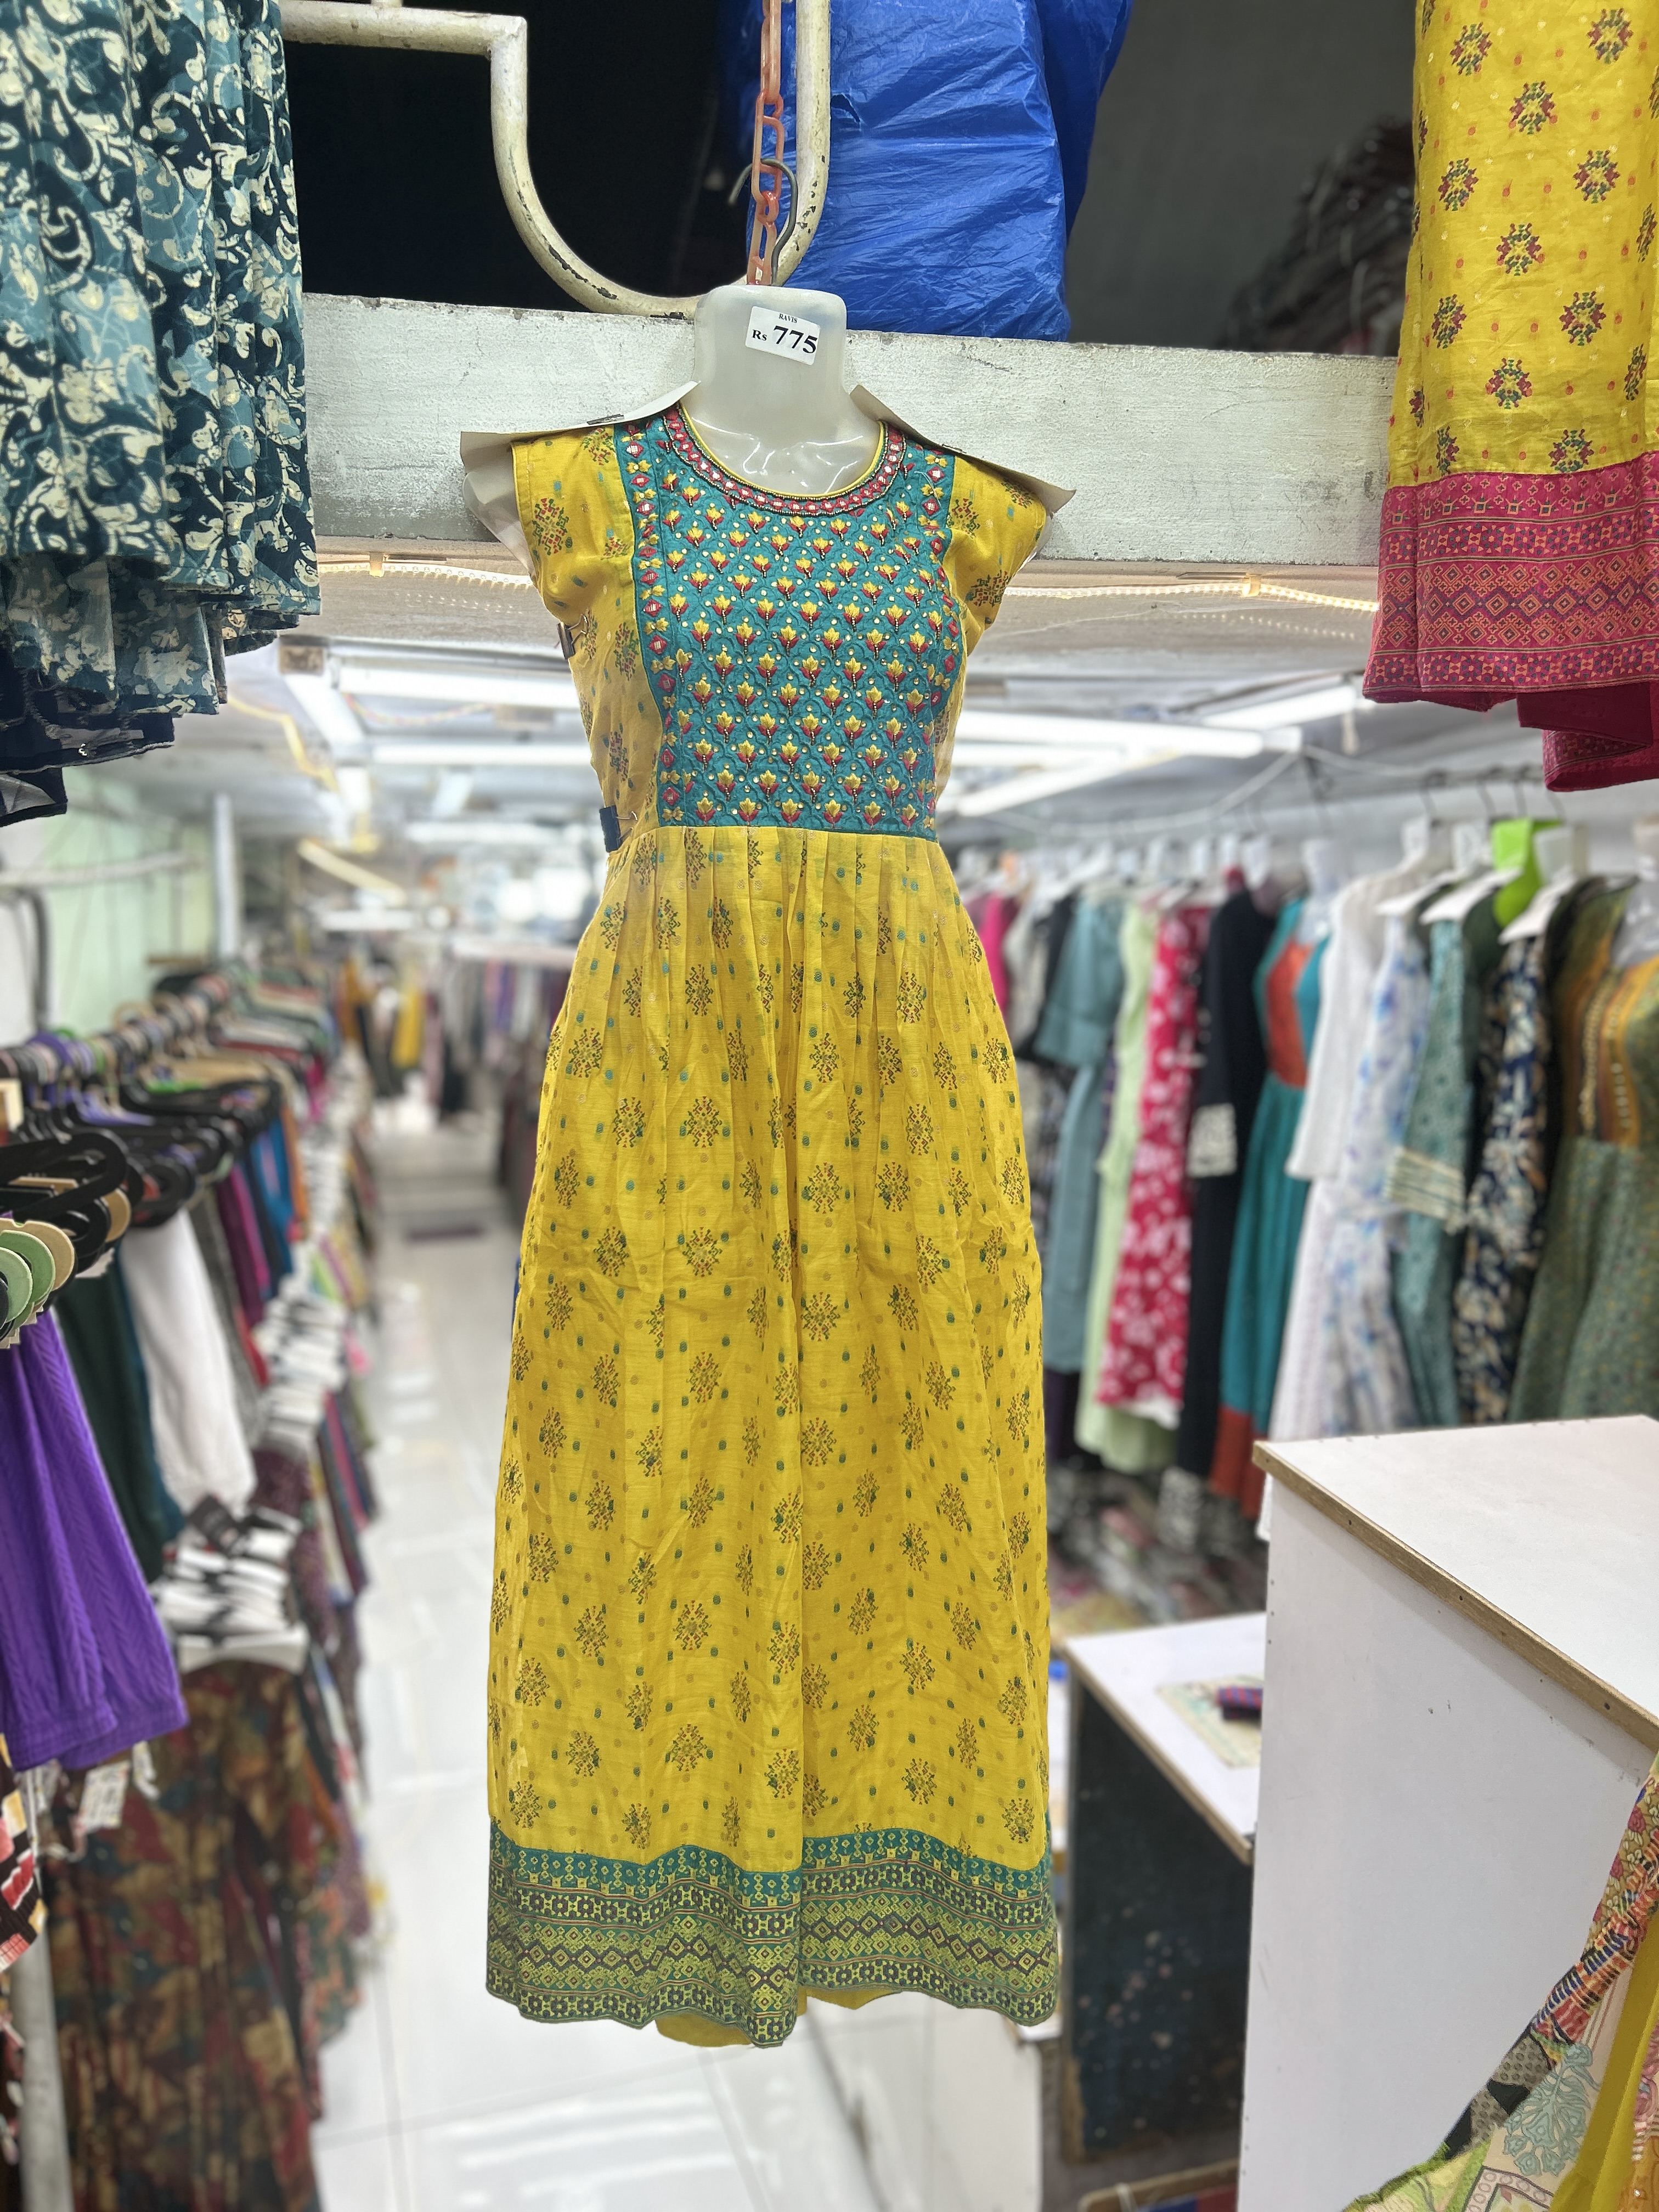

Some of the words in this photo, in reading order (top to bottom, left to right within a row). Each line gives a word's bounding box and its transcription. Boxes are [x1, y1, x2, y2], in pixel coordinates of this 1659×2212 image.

[778, 313, 798, 323] RAVIS
[752, 329, 768, 341] Rs
[774, 325, 818, 353] 775
